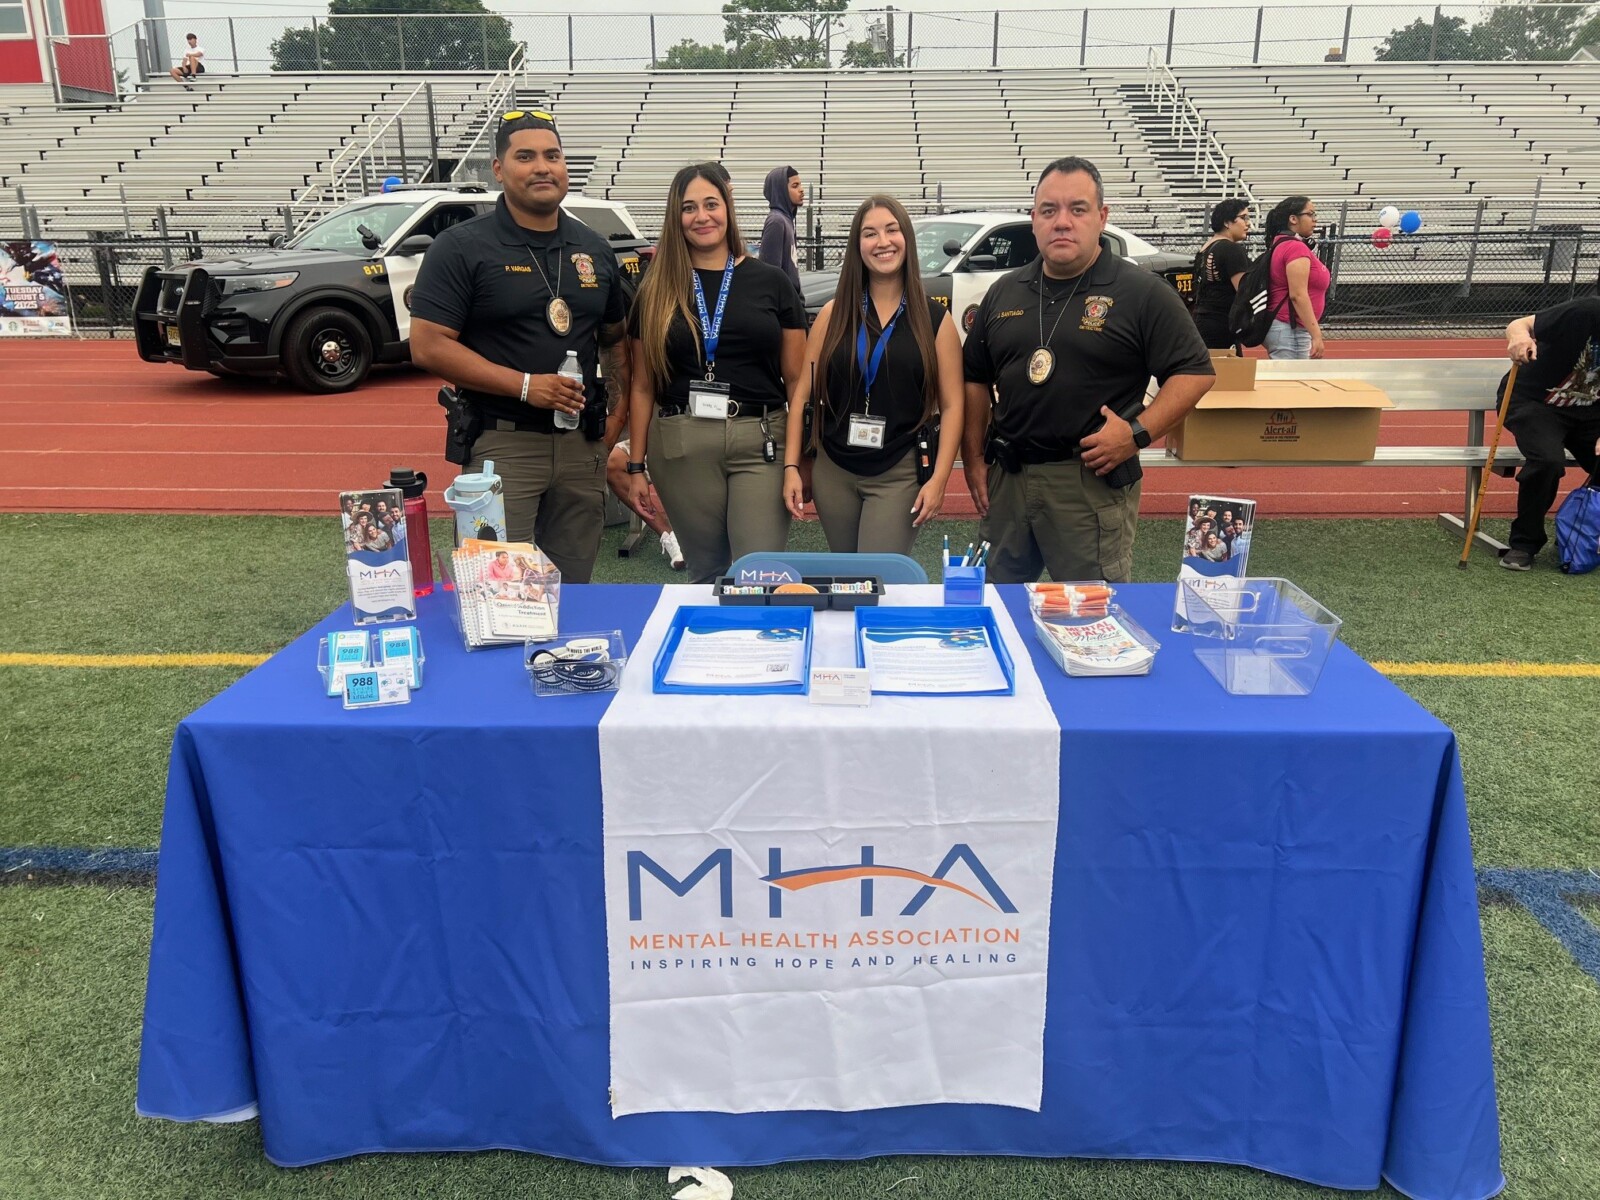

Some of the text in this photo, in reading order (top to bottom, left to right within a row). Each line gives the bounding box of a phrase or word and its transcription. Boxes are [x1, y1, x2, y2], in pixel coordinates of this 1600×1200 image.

[363, 264, 384, 275] 817
[14, 301, 38, 309] 2025
[1264, 425, 1297, 434] Alert-all
[360, 569, 401, 580] MHA
[741, 569, 793, 582] MHA
[832, 581, 871, 591] mental
[1065, 621, 1110, 632] MENTAL
[1068, 625, 1116, 637] HEALTH
[1074, 630, 1122, 642] Matters
[352, 677, 373, 687] 988
[813, 673, 840, 681] MHA
[627, 843, 1019, 921] MHA
[630, 928, 1020, 950] MENTAL HEALTH ASSOCIATION
[631, 953, 1017, 970] INSPIRING HOPE AND HEALING
